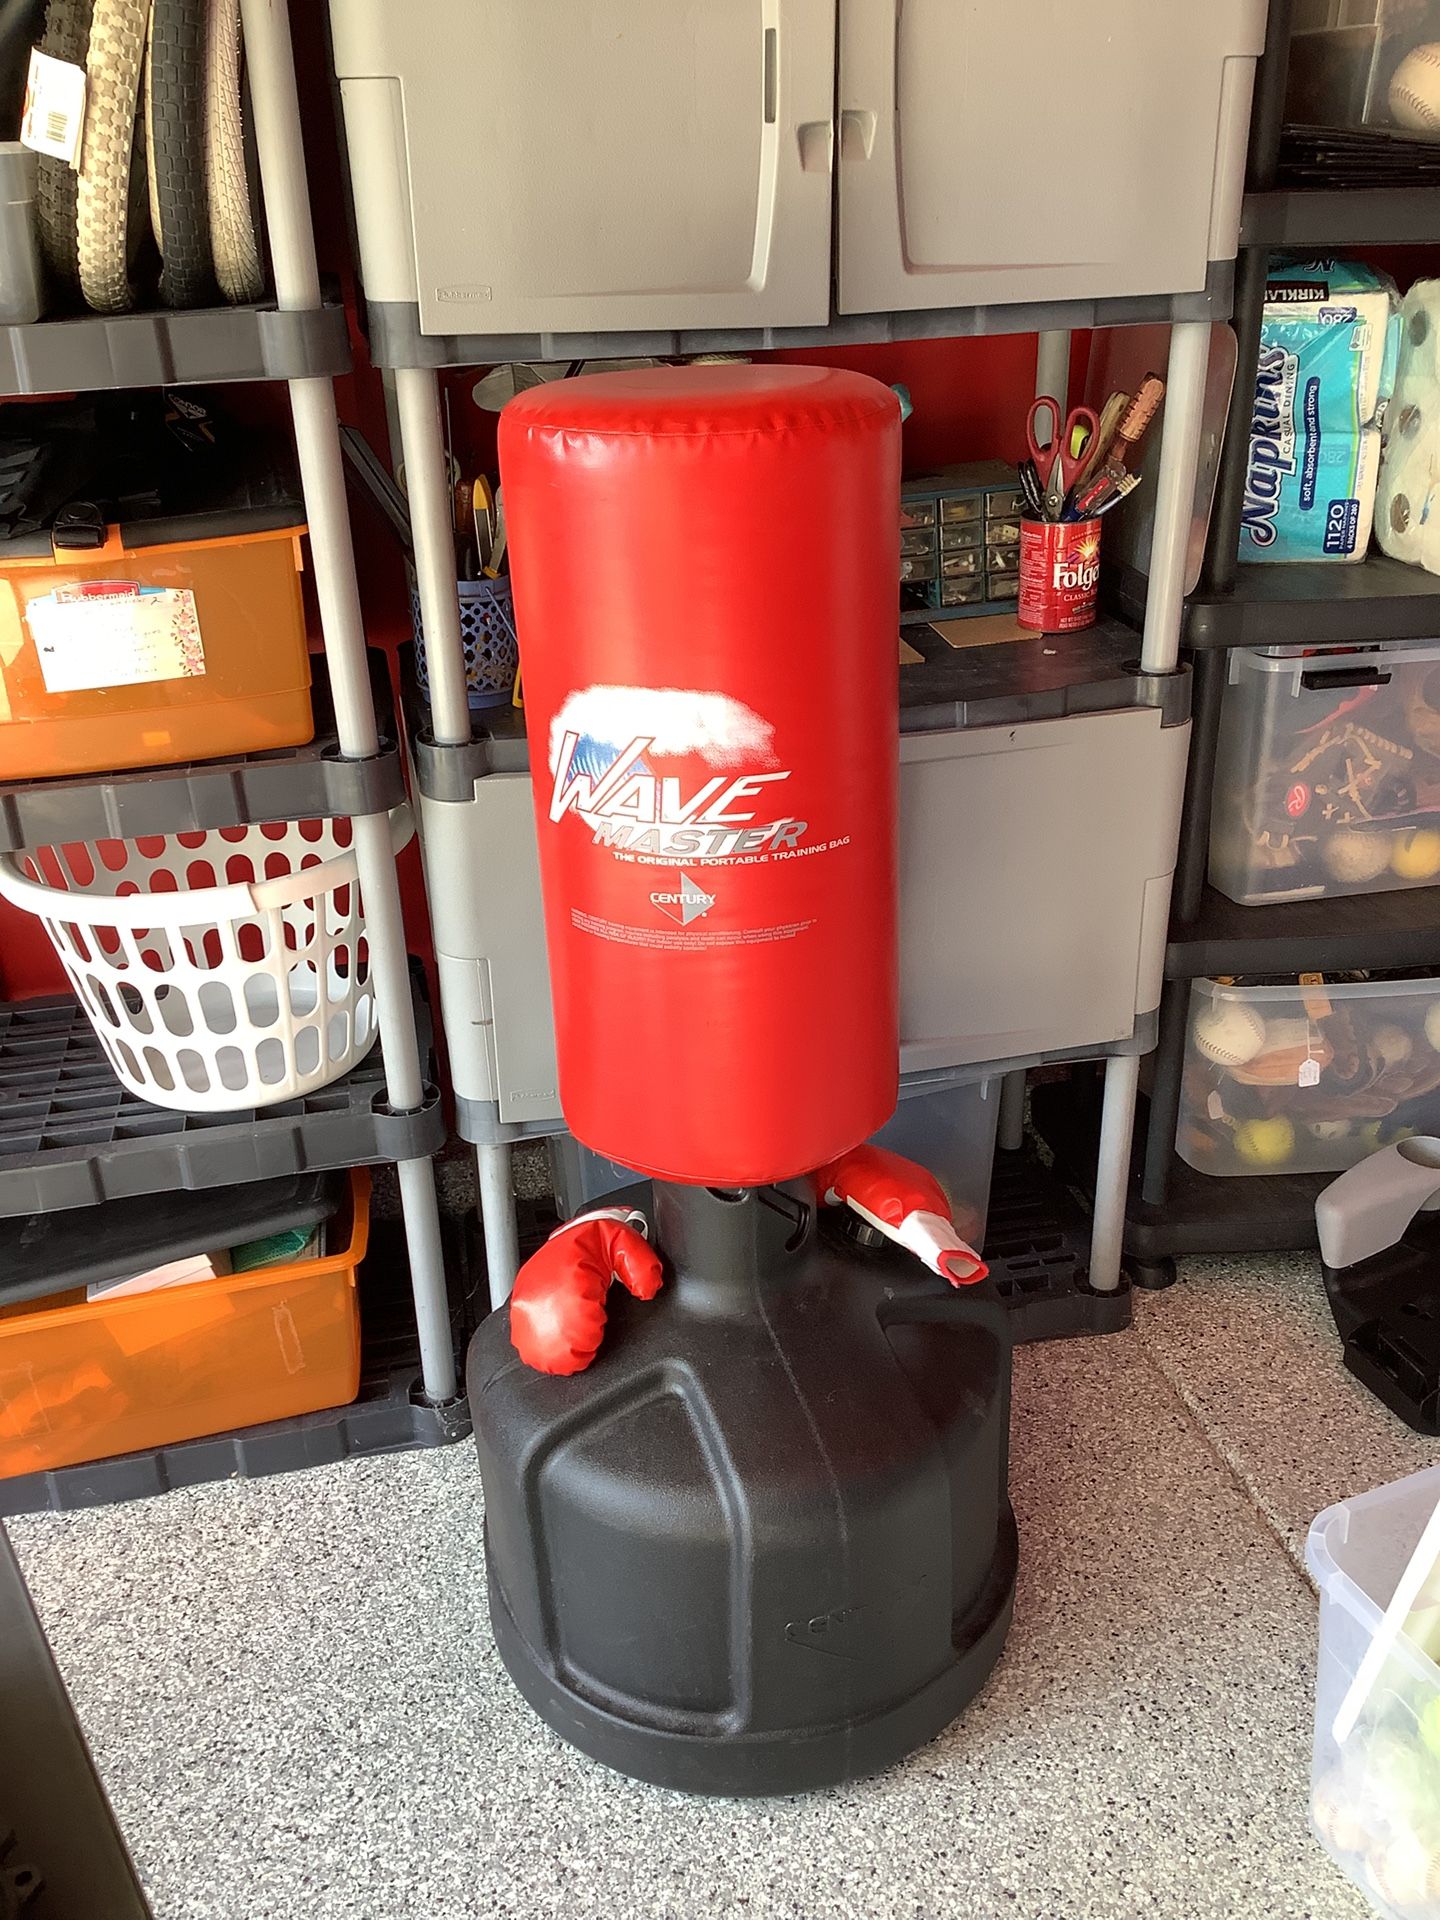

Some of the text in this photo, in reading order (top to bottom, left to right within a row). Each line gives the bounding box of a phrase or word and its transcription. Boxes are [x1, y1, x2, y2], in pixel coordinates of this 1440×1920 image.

[1282, 363, 1295, 454] CASUAL DINING
[1241, 346, 1296, 547] Napkins
[1303, 385, 1317, 501] soft, absorbent and strong
[1326, 504, 1344, 548] 1120
[1347, 525, 1355, 544] PACKS
[62, 588, 135, 603] Rubbermaid
[549, 730, 792, 823] WAVE
[592, 818, 808, 855] MASTER
[612, 836, 850, 867] THE ORIGINAL PORTABLE TRAINING BAG
[650, 892, 716, 905] CENTURY
